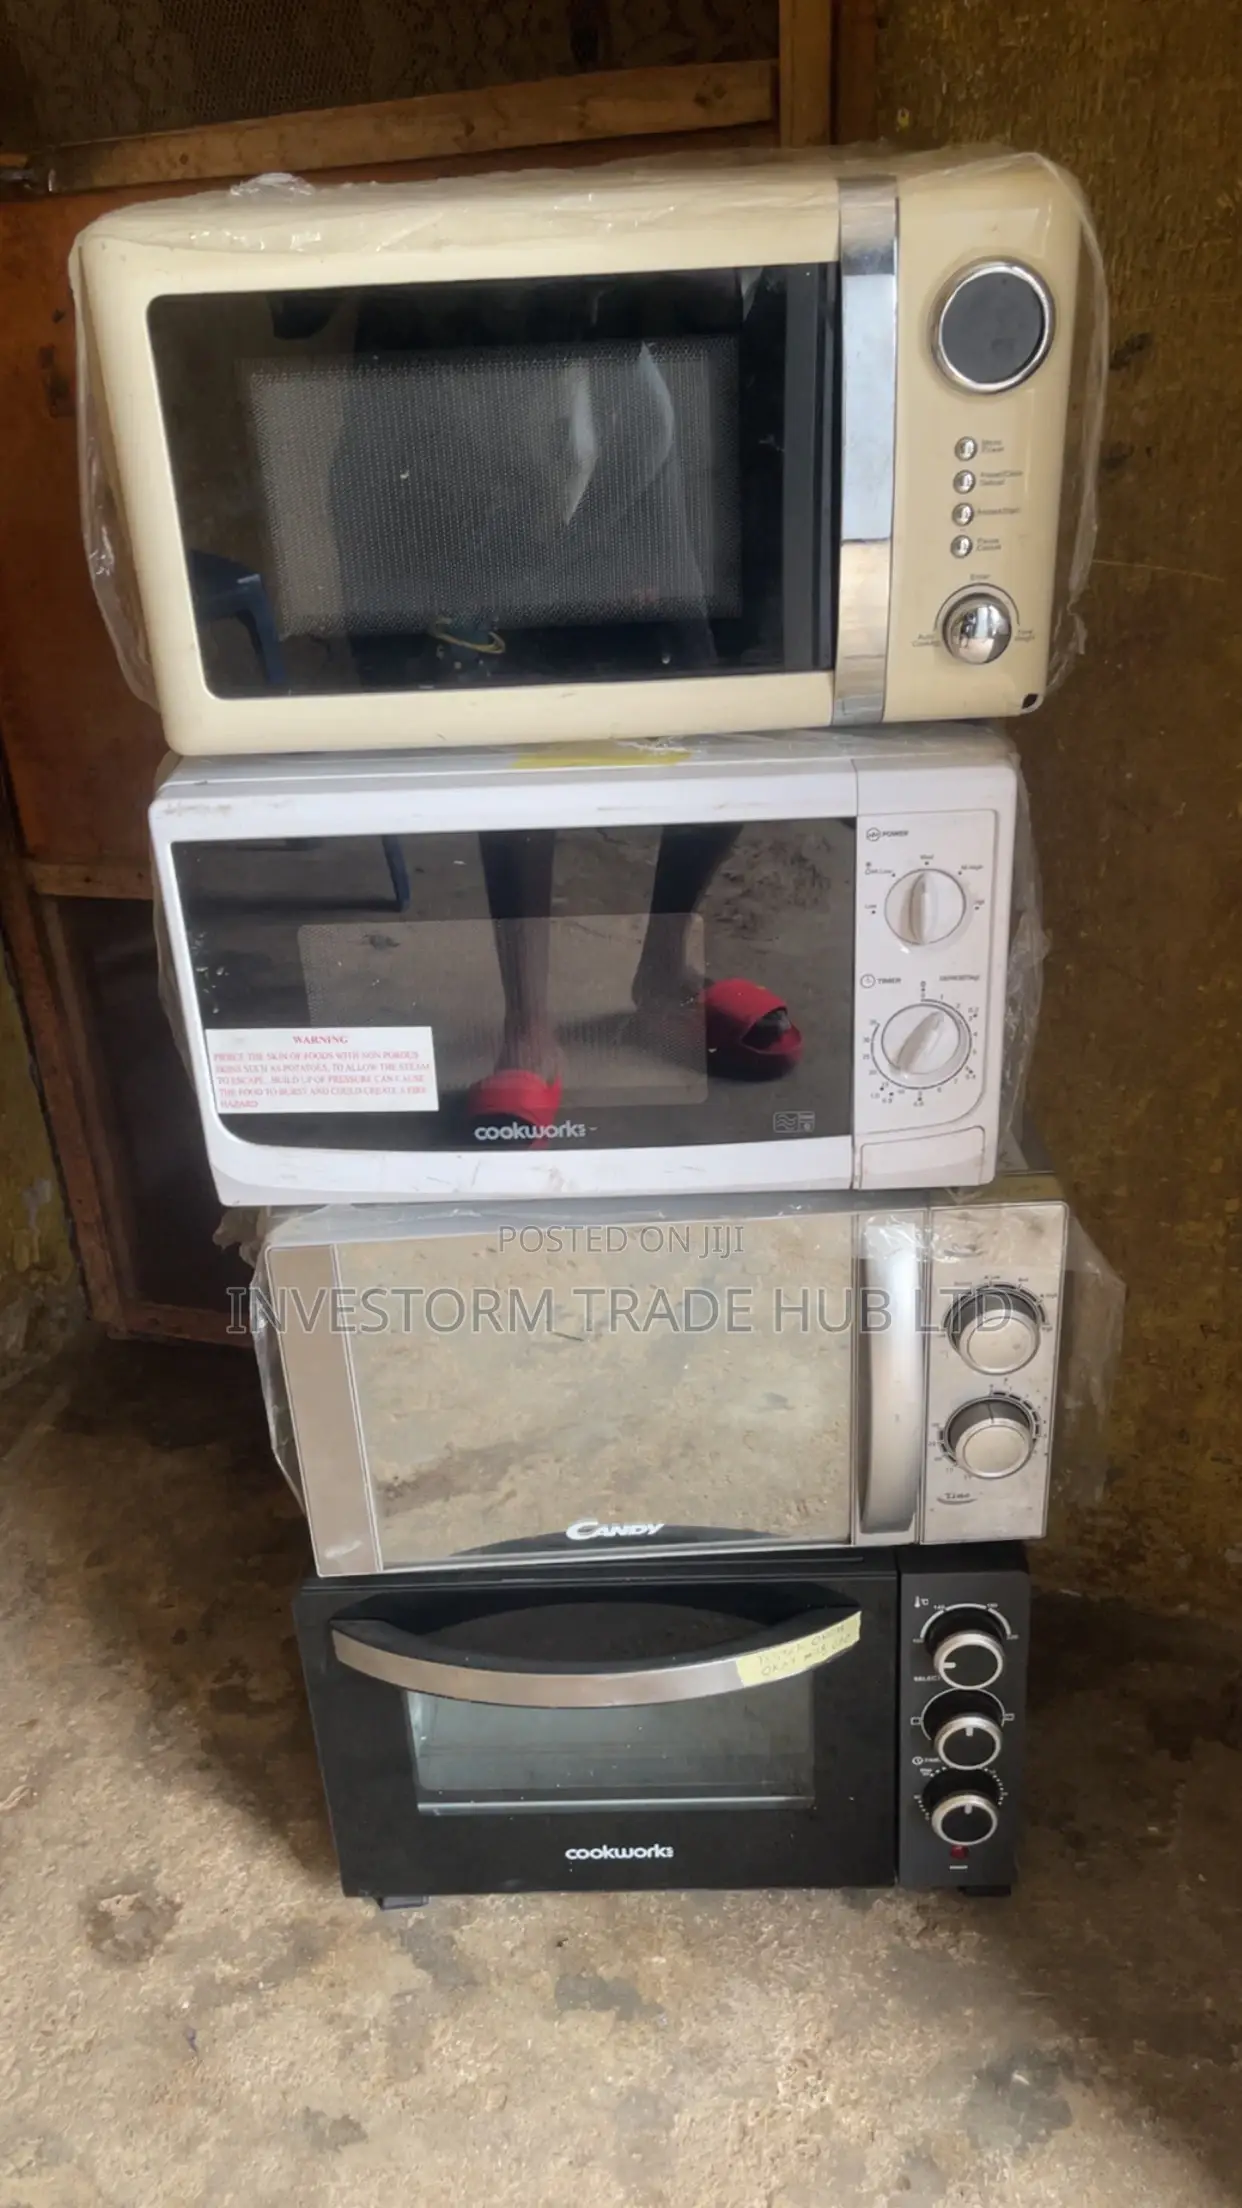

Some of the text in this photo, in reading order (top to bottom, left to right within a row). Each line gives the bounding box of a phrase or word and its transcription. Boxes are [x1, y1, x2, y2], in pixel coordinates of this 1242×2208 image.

[882, 829, 909, 837] POWER
[292, 1035, 348, 1045] WARNING
[247, 1052, 263, 1061] THE
[266, 1052, 288, 1060] SKIN
[289, 1052, 301, 1060] OF
[303, 1051, 334, 1060] FOODS
[335, 1051, 359, 1060] WITH
[361, 1051, 382, 1059] NON
[244, 1064, 268, 1073] SUCH
[271, 1064, 283, 1073] AS
[332, 1062, 344, 1072] TO
[346, 1062, 378, 1072] ALLOW
[380, 1062, 396, 1071] THE
[399, 1061, 430, 1071] STEAM
[217, 1076, 229, 1085] TO
[270, 1076, 300, 1084] BUILD
[302, 1076, 314, 1084] UP
[328, 1075, 372, 1084] PRESSURE
[373, 1075, 394, 1083] CAN
[394, 1074, 425, 1082] CAUSE
[218, 1088, 237, 1097] THE
[238, 1088, 263, 1096] FOOD
[265, 1088, 277, 1096] TO
[278, 1087, 307, 1096] BURST
[309, 1087, 330, 1096] AND
[330, 1086, 363, 1096] COULD
[363, 1086, 397, 1096] CREATE
[406, 1085, 428, 1094] FIRE
[220, 1100, 259, 1109] HAZARD
[473, 1119, 587, 1141] cookworks
[564, 1519, 666, 1541] CANDY
[564, 1843, 675, 1861] cookworks
